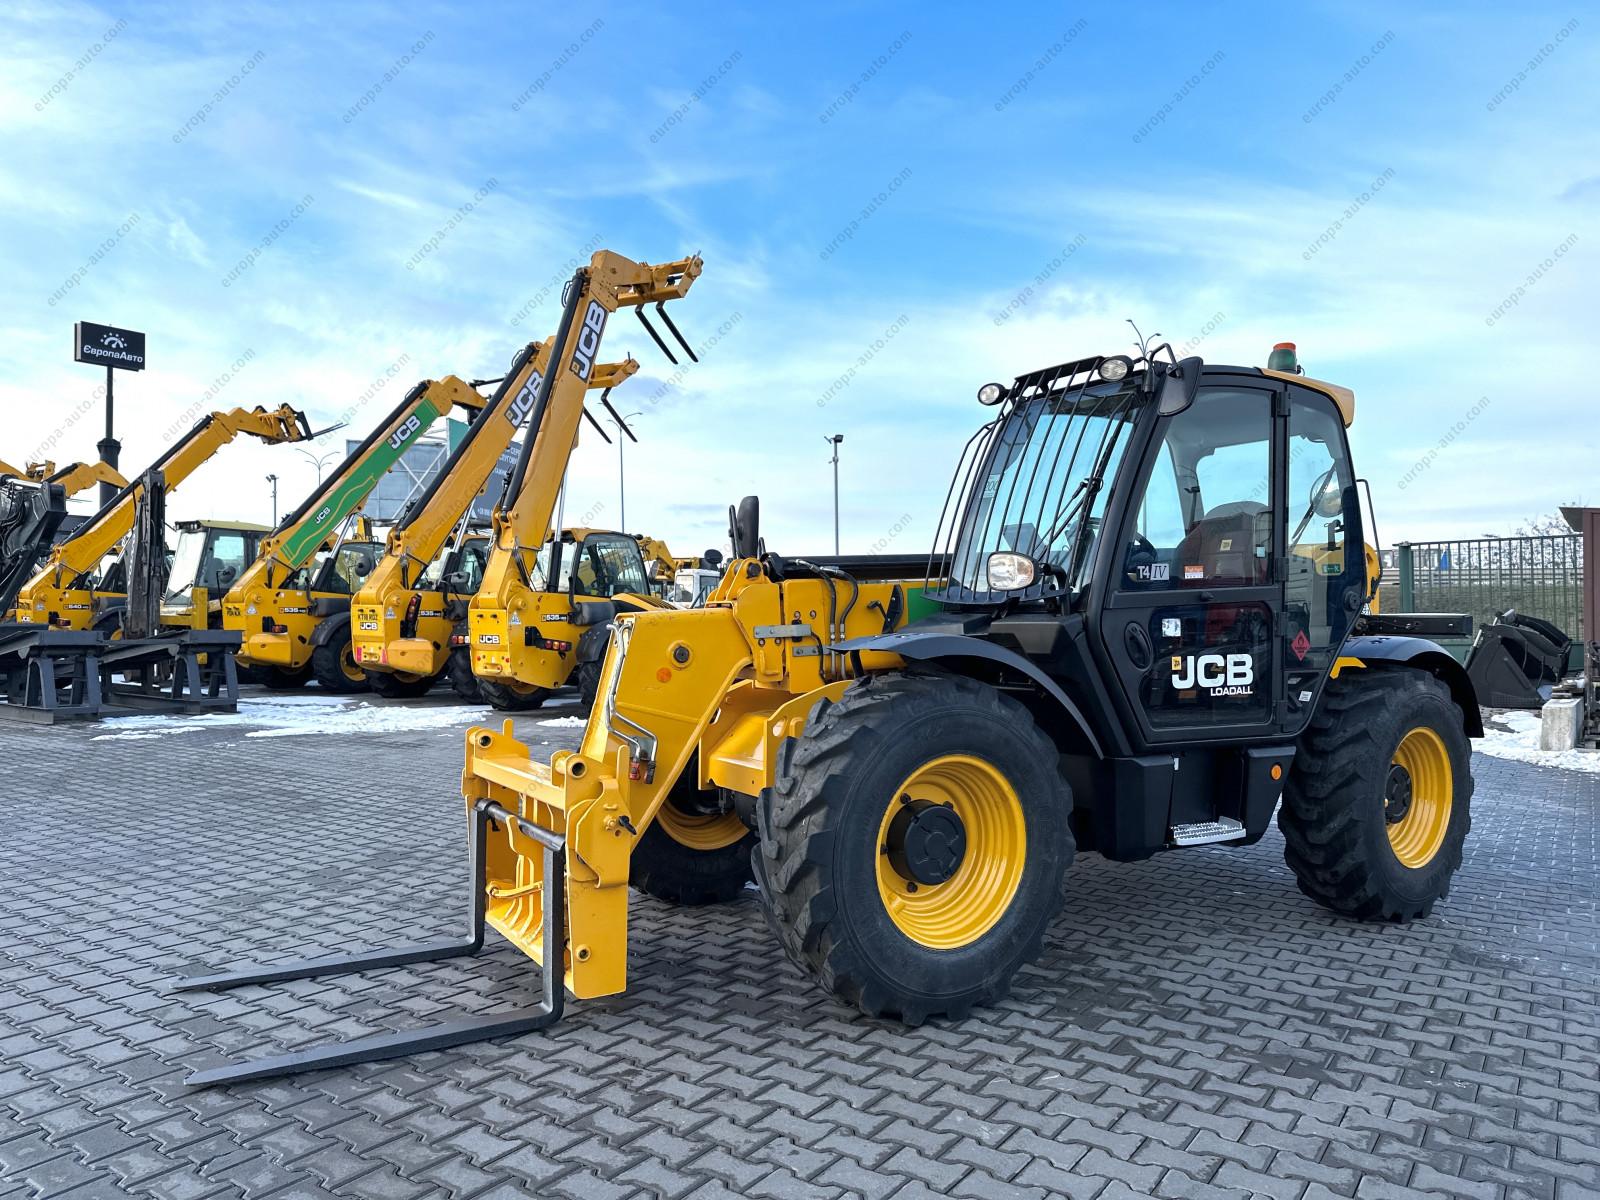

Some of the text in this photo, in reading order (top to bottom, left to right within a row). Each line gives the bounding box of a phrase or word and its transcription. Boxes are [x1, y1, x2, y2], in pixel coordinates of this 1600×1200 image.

[575, 300, 605, 379] JCB
[83, 344, 143, 363] ЄвропаАвто
[511, 371, 543, 427] JCB
[391, 415, 421, 449] JCB
[315, 507, 331, 524] JCB
[1138, 565, 1167, 579] T4 IV
[361, 622, 378, 630] JCB
[480, 635, 500, 643] JCB
[1172, 653, 1254, 690] JCB
[1210, 685, 1254, 697] LOADALL
